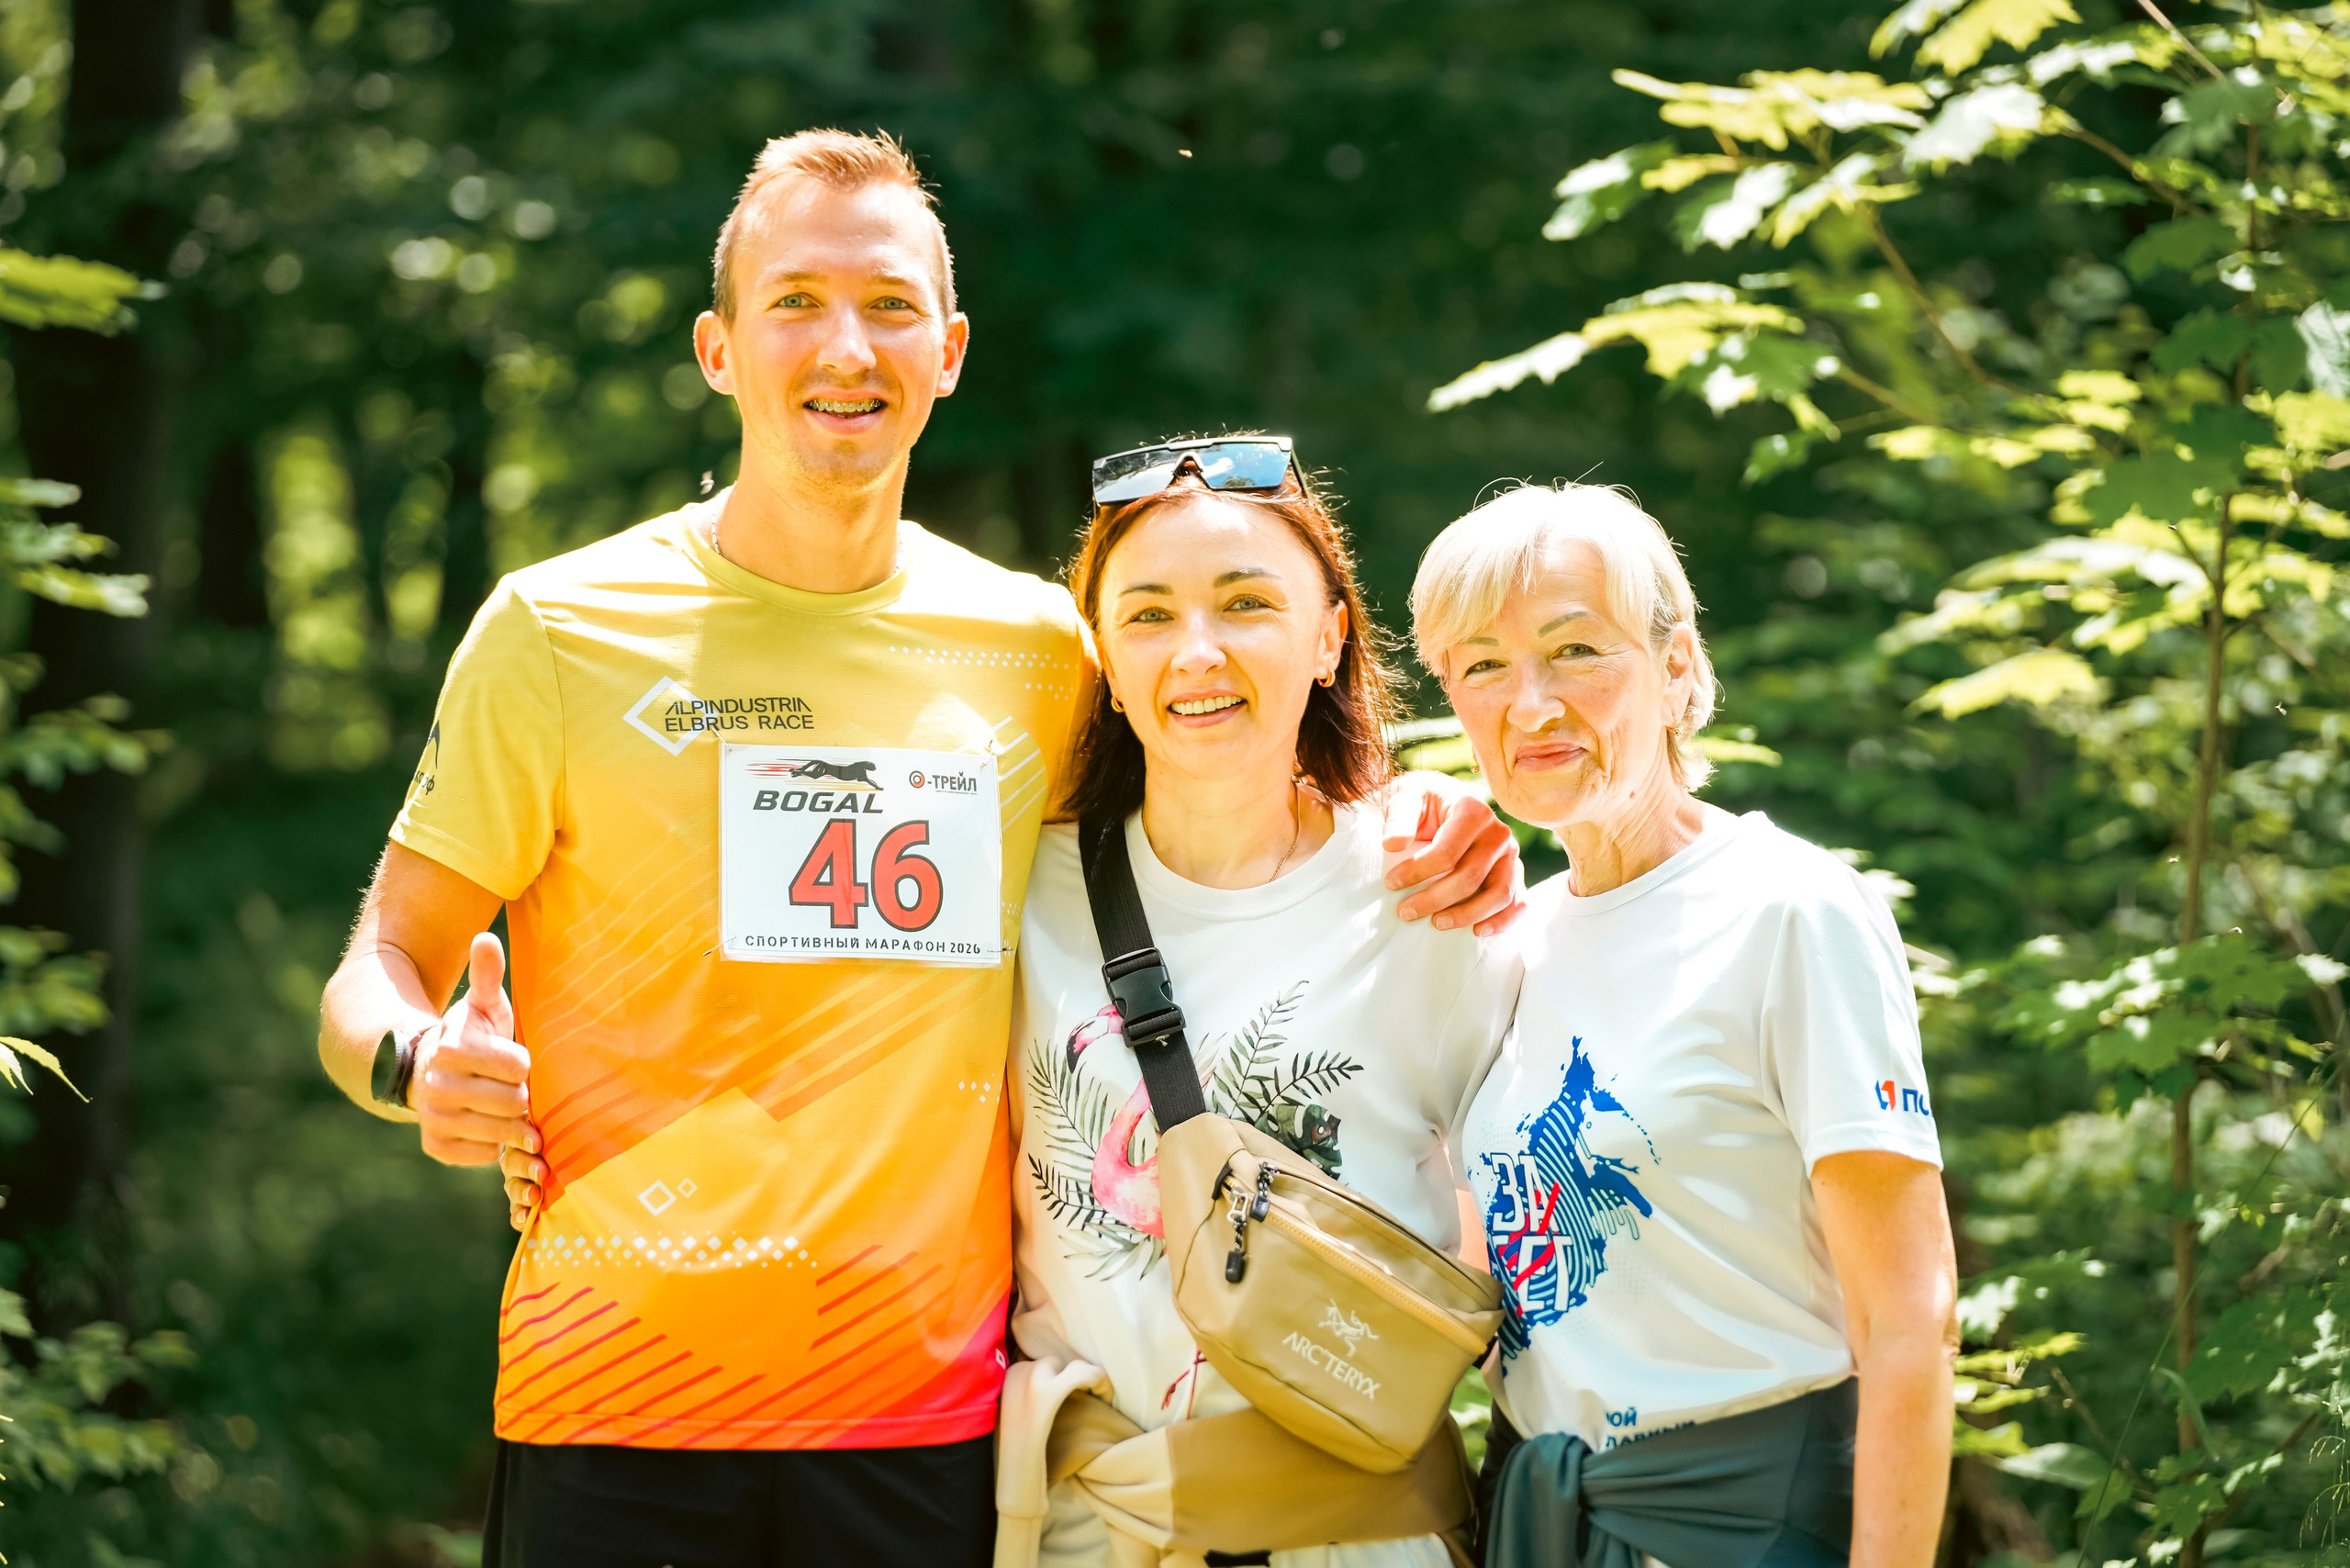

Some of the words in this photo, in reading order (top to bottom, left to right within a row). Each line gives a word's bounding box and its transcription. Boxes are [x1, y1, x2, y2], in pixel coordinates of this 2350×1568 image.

[665, 698, 812, 715] ALPINDUSTRIA
[665, 715, 749, 732] ELBRUS
[758, 714, 815, 730] RACE
[753, 790, 884, 814] BOGAL
[789, 818, 944, 932] 46
[744, 935, 860, 950] СПОРТИВНЫЙ
[866, 938, 946, 953] МАРАФОН
[950, 942, 981, 954] 2026
